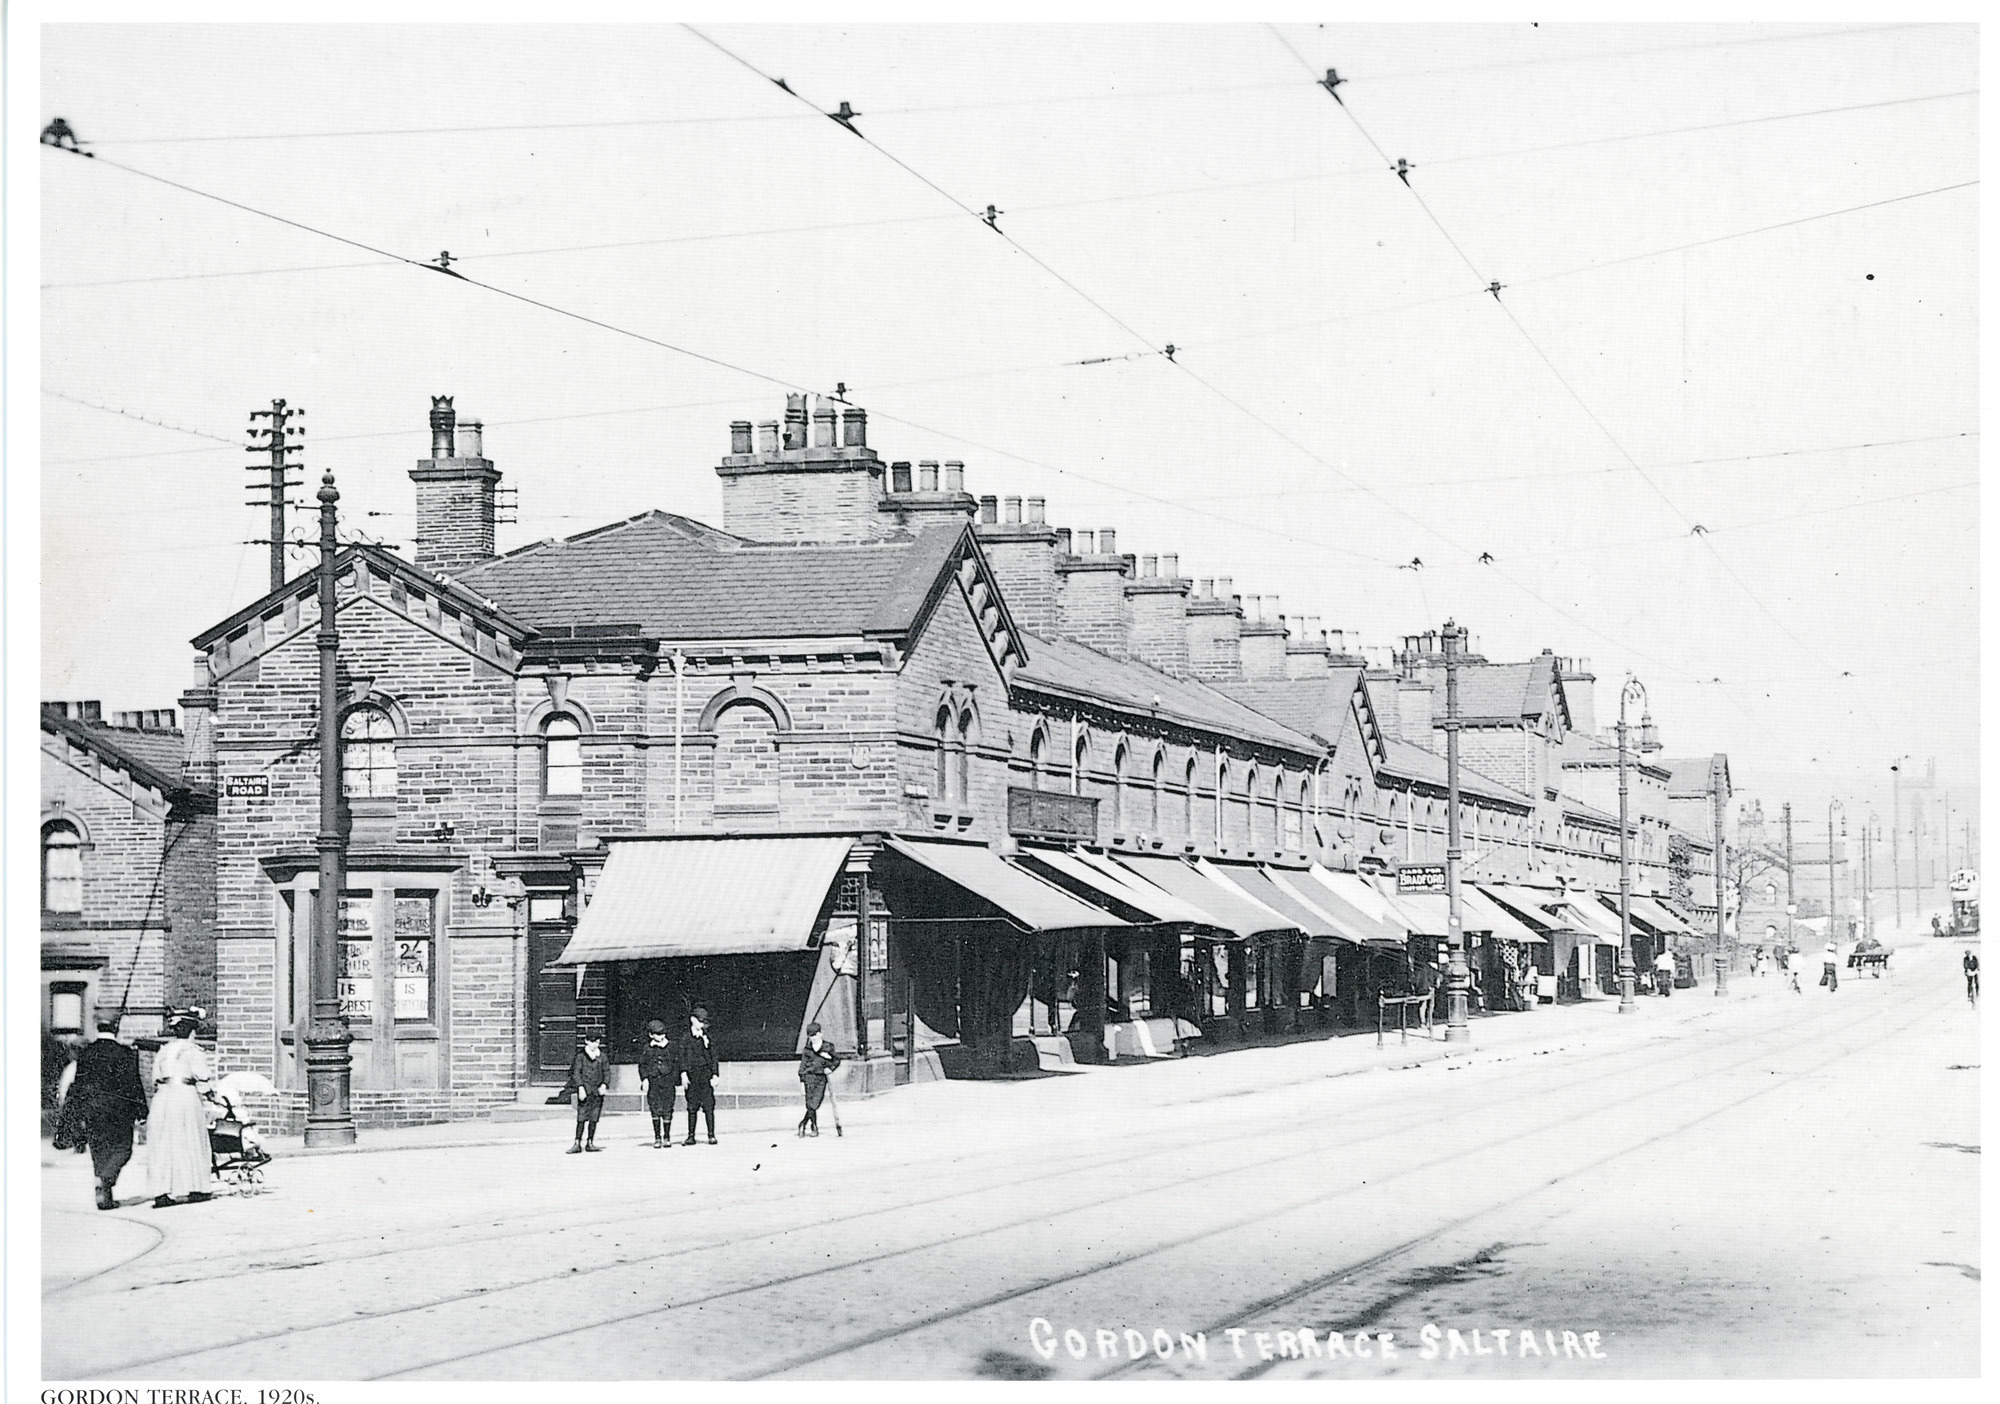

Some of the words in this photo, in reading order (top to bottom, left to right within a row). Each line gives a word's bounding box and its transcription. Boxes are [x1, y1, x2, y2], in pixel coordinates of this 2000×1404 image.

[227, 777, 267, 785] SALTAIRE
[232, 786, 263, 795] ROAD
[1400, 873, 1444, 885] BRADFORD
[347, 1000, 372, 1012] BEST
